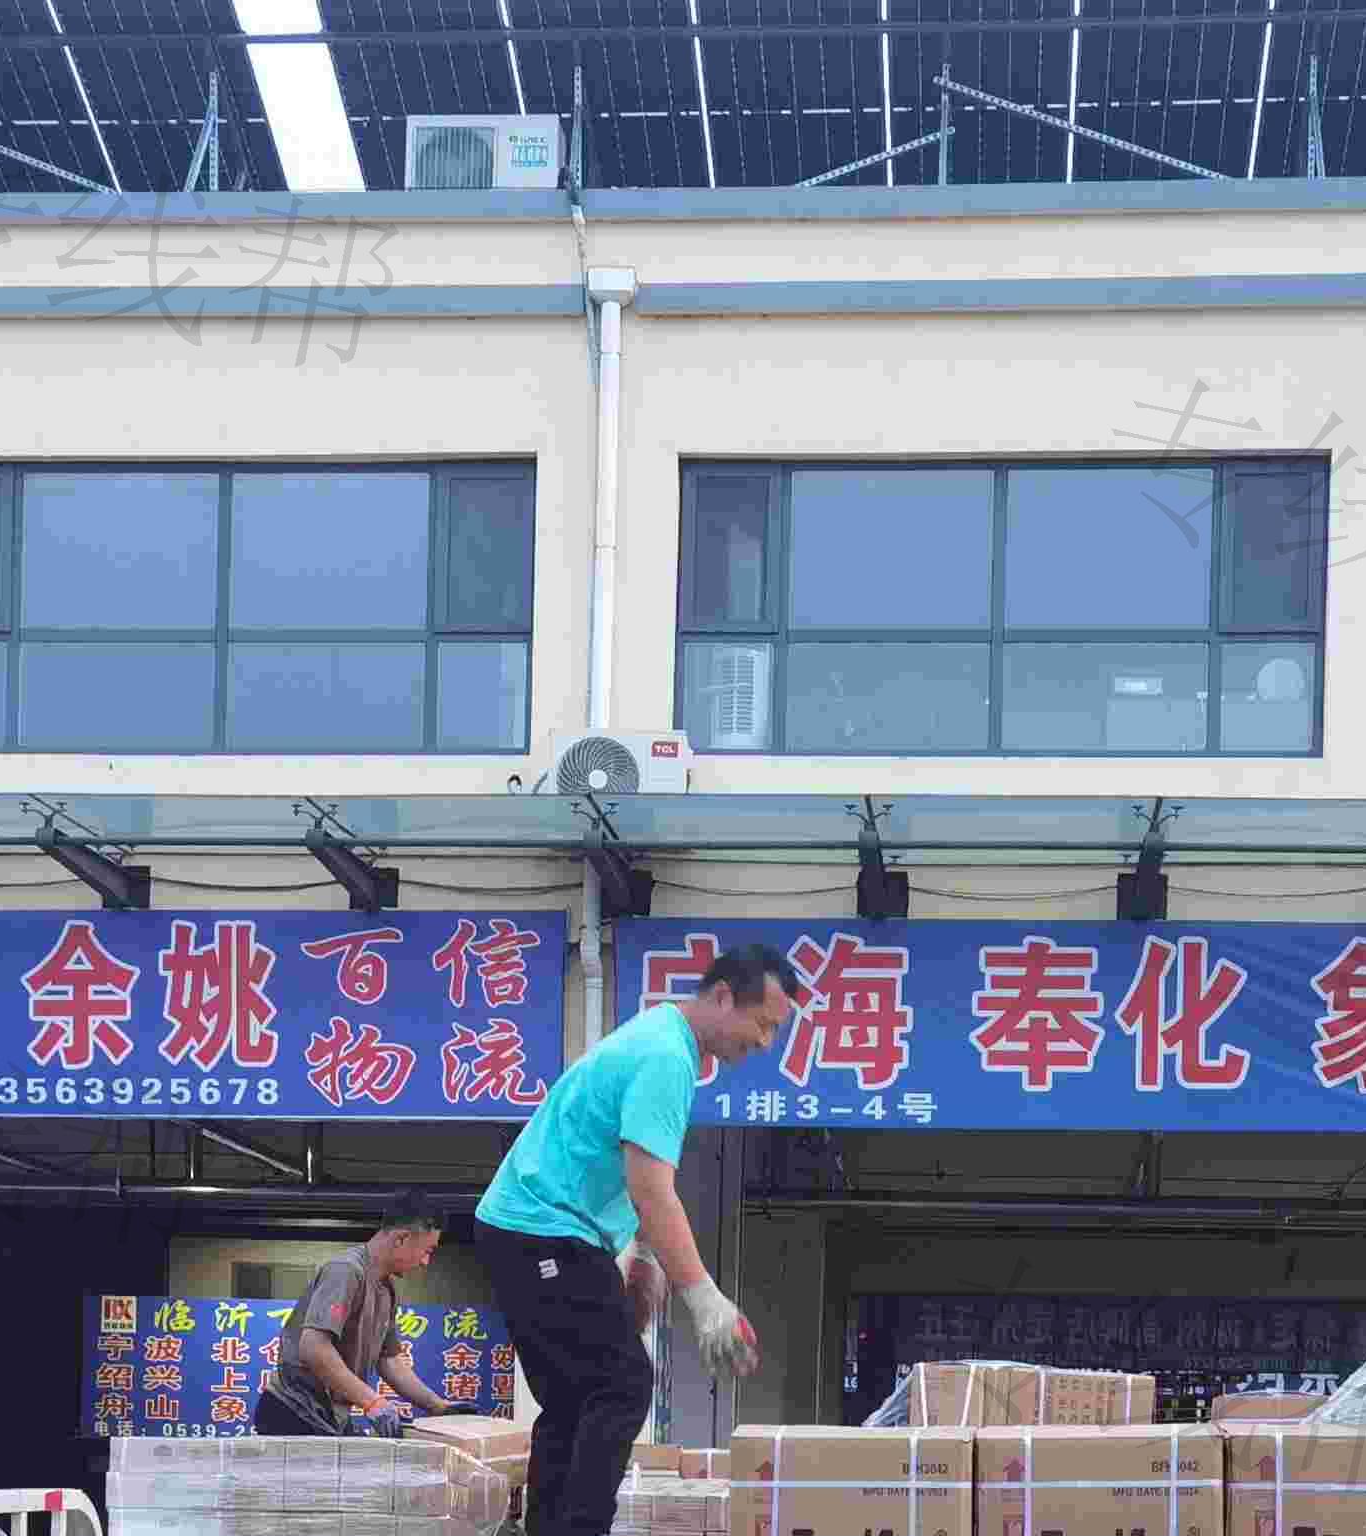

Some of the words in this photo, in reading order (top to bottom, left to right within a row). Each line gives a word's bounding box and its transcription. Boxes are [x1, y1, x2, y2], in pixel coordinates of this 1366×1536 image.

[653, 743, 676, 754] TCL
[21, 919, 278, 1071] 余姚
[301, 918, 541, 1008] 百信
[971, 936, 1250, 1092] 奉化
[303, 1016, 546, 1107] 物流
[98, 1334, 183, 1361] 宁波
[94, 1393, 180, 1422] 舟山
